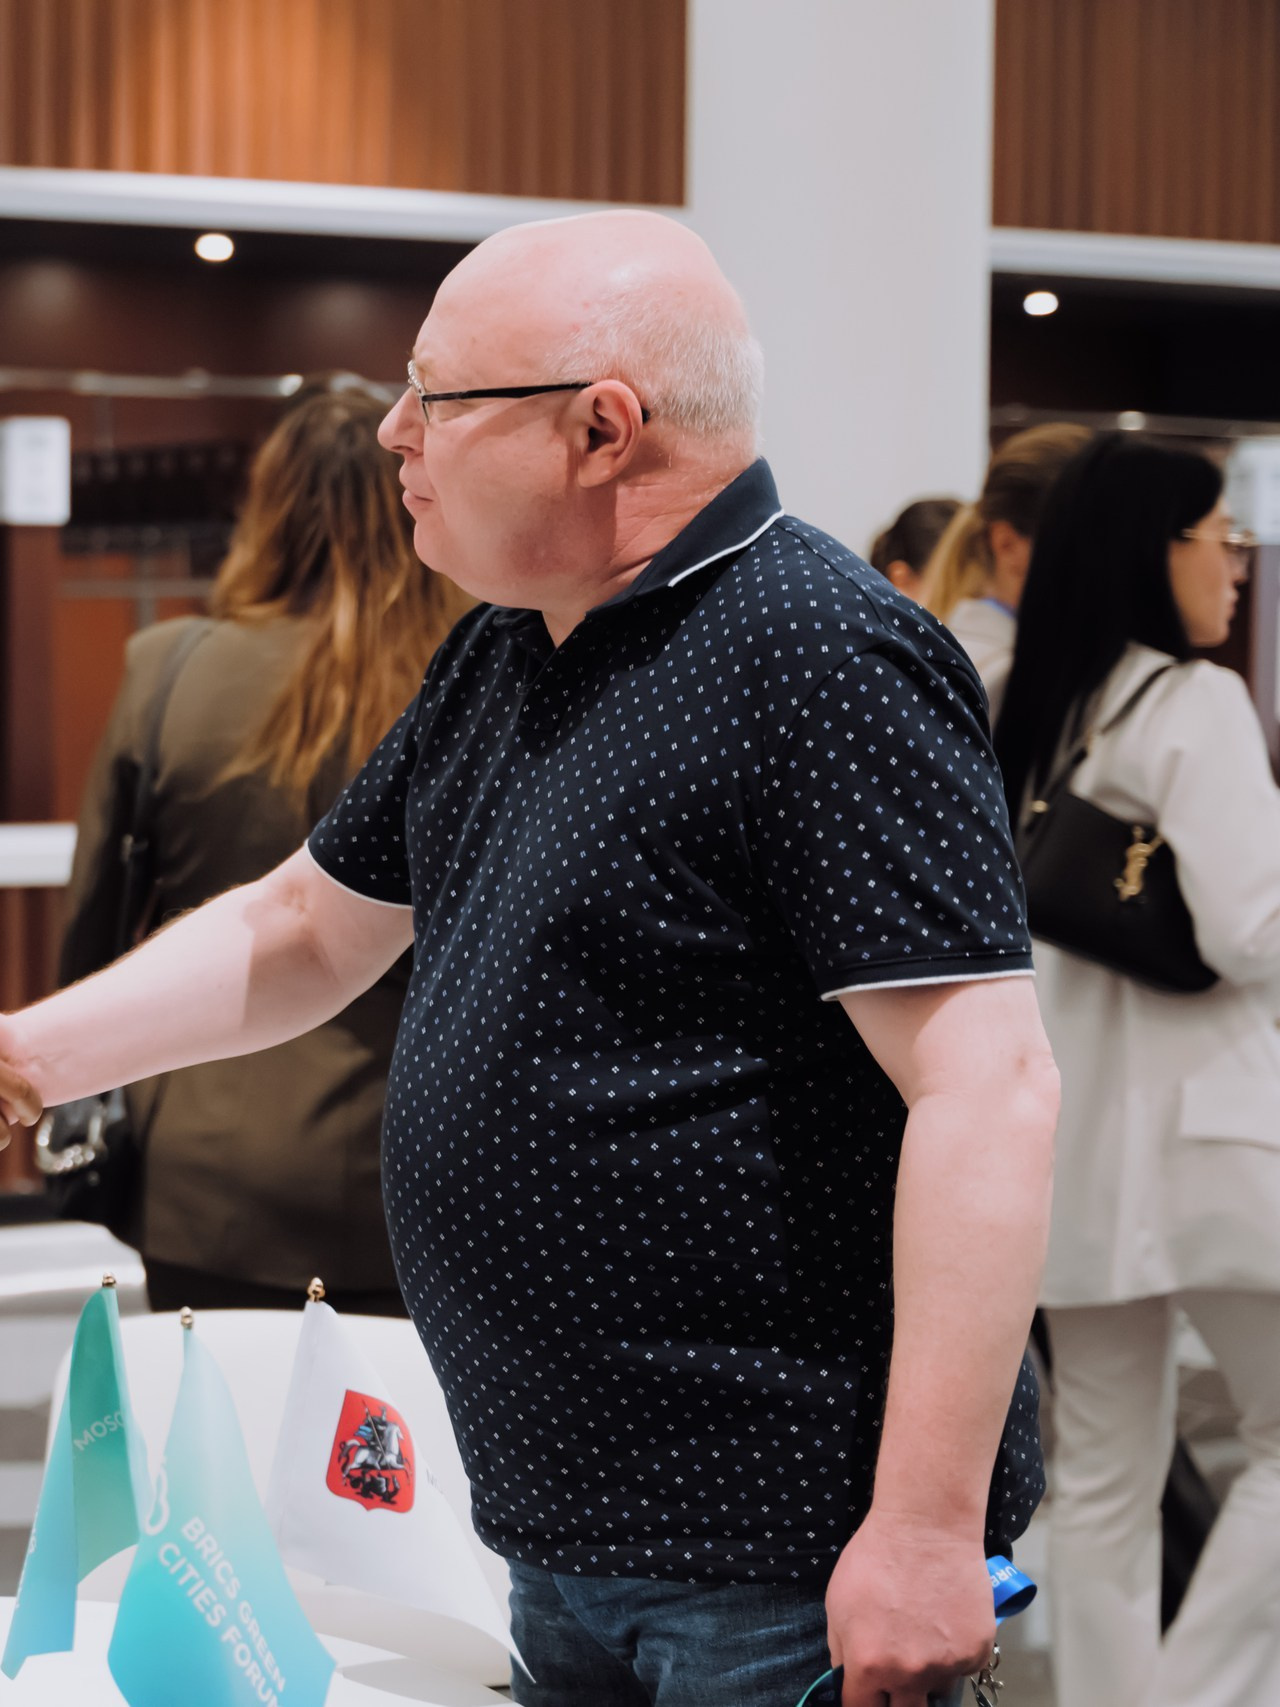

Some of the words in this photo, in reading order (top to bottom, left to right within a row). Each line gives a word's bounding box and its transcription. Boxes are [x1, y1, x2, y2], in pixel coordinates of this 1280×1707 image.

[158, 1542, 227, 1628] CITIES
[181, 1516, 241, 1600] BRICS
[238, 1600, 286, 1692] GREEN
